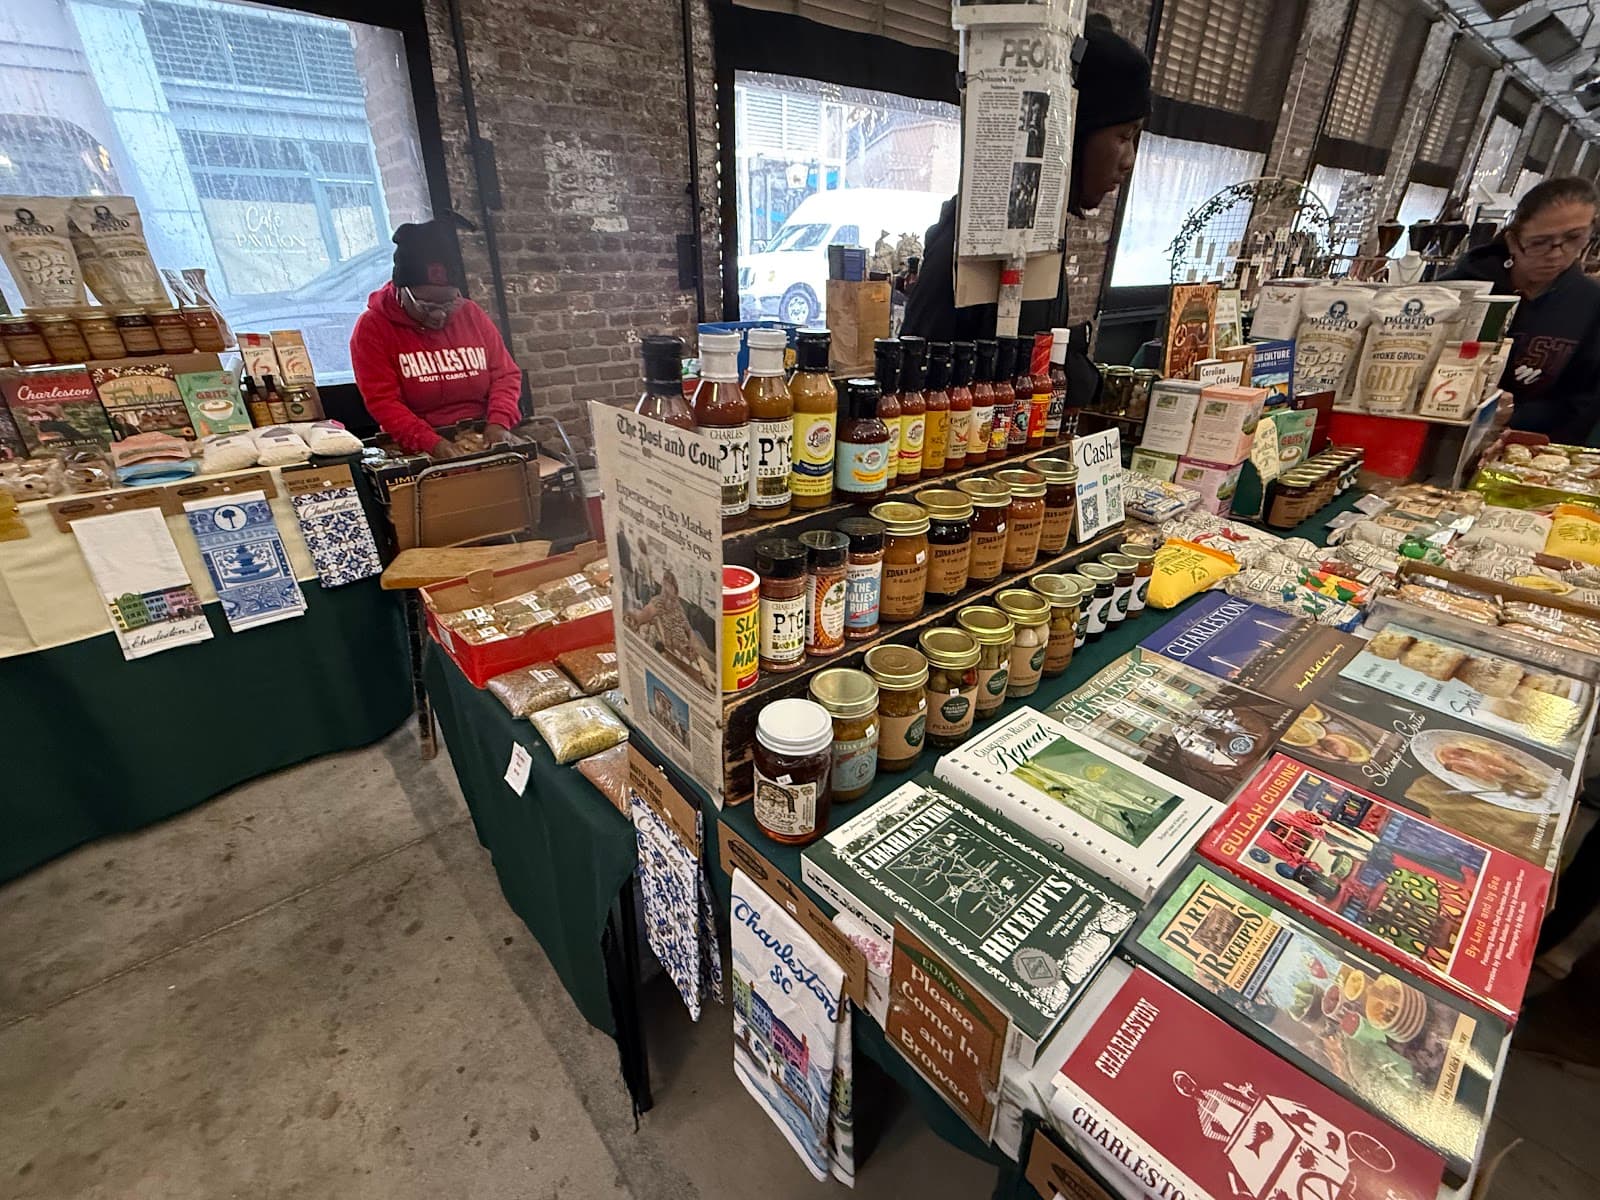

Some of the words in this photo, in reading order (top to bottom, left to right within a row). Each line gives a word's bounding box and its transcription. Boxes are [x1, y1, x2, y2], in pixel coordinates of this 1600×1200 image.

[235, 231, 308, 250] PAVILION
[1310, 317, 1358, 330] PALMETTO
[1383, 316, 1436, 326] PALMETTO
[1201, 366, 1226, 377] Carolina
[1264, 348, 1291, 360] CULTURE
[17, 386, 93, 402] Charleston
[196, 389, 229, 399] GRITS
[1215, 375, 1240, 385] Cooking
[616, 413, 637, 440] The
[638, 420, 662, 449] Post
[664, 431, 685, 458] and
[1083, 436, 1114, 467] Cash
[303, 500, 359, 519] Charleston
[853, 582, 871, 592] THE
[850, 602, 869, 612] RUB
[1165, 600, 1250, 657] CHARLESTON
[1055, 701, 1077, 713] The
[1072, 681, 1100, 703] Grand
[1062, 661, 1163, 730] CHARLESTON
[973, 733, 1012, 758] CHARLESTON
[1008, 716, 1037, 738] RECEIPTS
[1361, 750, 1413, 787] Shrimp
[1392, 711, 1426, 738] Grits
[1220, 802, 1268, 856] GULLAH
[1260, 762, 1300, 805] CUISINE
[637, 815, 692, 888] Charleston
[860, 802, 954, 870] CHARLESTON
[1484, 891, 1495, 905] by
[1487, 874, 1501, 893] Sea
[979, 874, 1073, 964] RECEIPTS
[1046, 920, 1064, 938] Serving
[1064, 891, 1090, 916] Lowcountry
[1065, 917, 1079, 931] Over
[1078, 902, 1092, 916] Years
[1164, 883, 1236, 960] PARTY
[1480, 902, 1493, 920] and
[1200, 905, 1264, 980] RECEIPTS
[1470, 918, 1486, 945] Land
[733, 894, 838, 1023] Charleston
[1233, 956, 1258, 989] CHARLESTON
[1255, 940, 1269, 962] JUNIOR
[1265, 925, 1279, 942] LEAGUE
[1464, 944, 1481, 959] By
[769, 964, 793, 995] SC
[921, 957, 966, 1001] EDNA'S
[911, 964, 975, 1034] Please
[902, 980, 954, 1038] Come
[959, 1035, 980, 1066] In
[1095, 996, 1159, 1080] CHARLESTON
[919, 1027, 954, 1065] and
[901, 1027, 970, 1105] Browse
